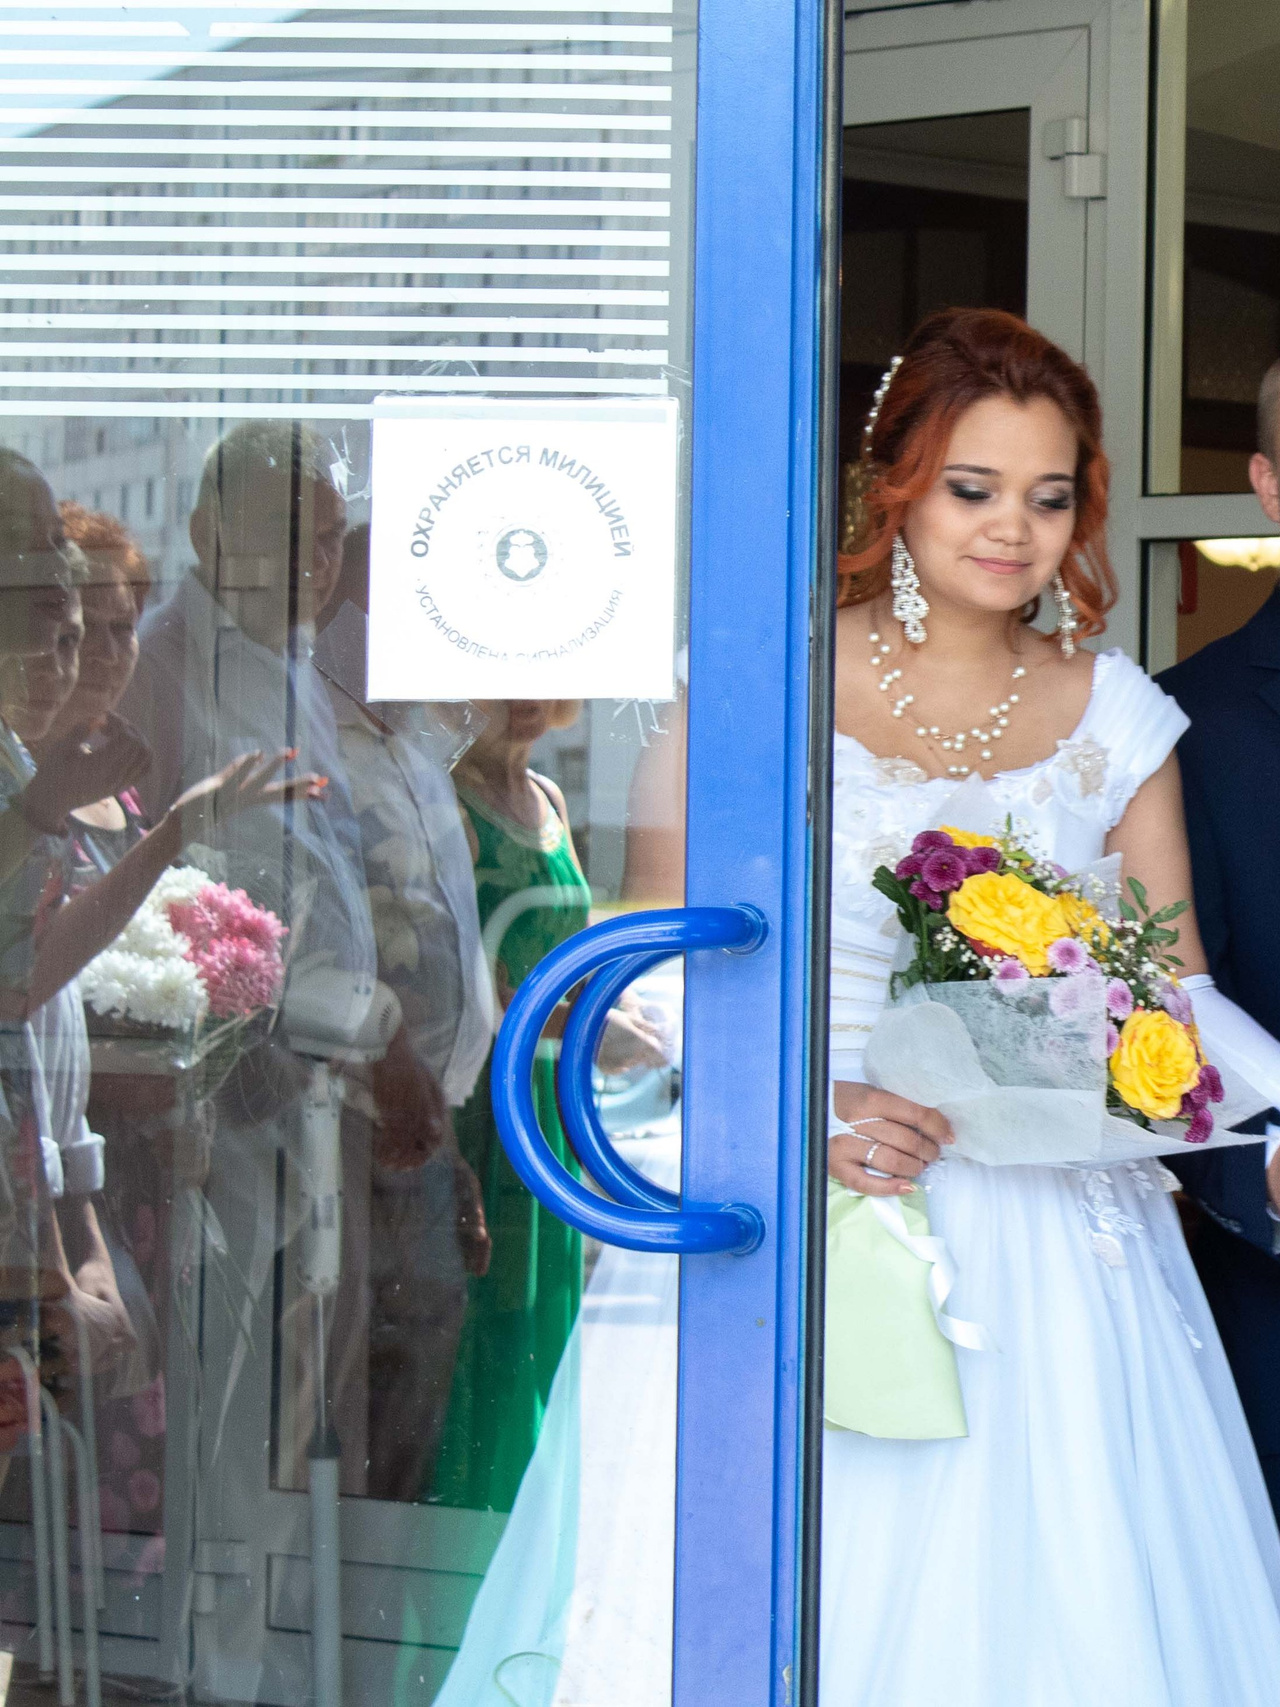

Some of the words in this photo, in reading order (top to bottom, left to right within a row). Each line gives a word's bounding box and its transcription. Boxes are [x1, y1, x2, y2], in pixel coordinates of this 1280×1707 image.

[410, 445, 531, 558] ОХРАНЯЕТСЯ
[538, 447, 635, 558] МИЛИЦИЕЙ
[415, 585, 509, 661] УСТАНОВЛЕНА
